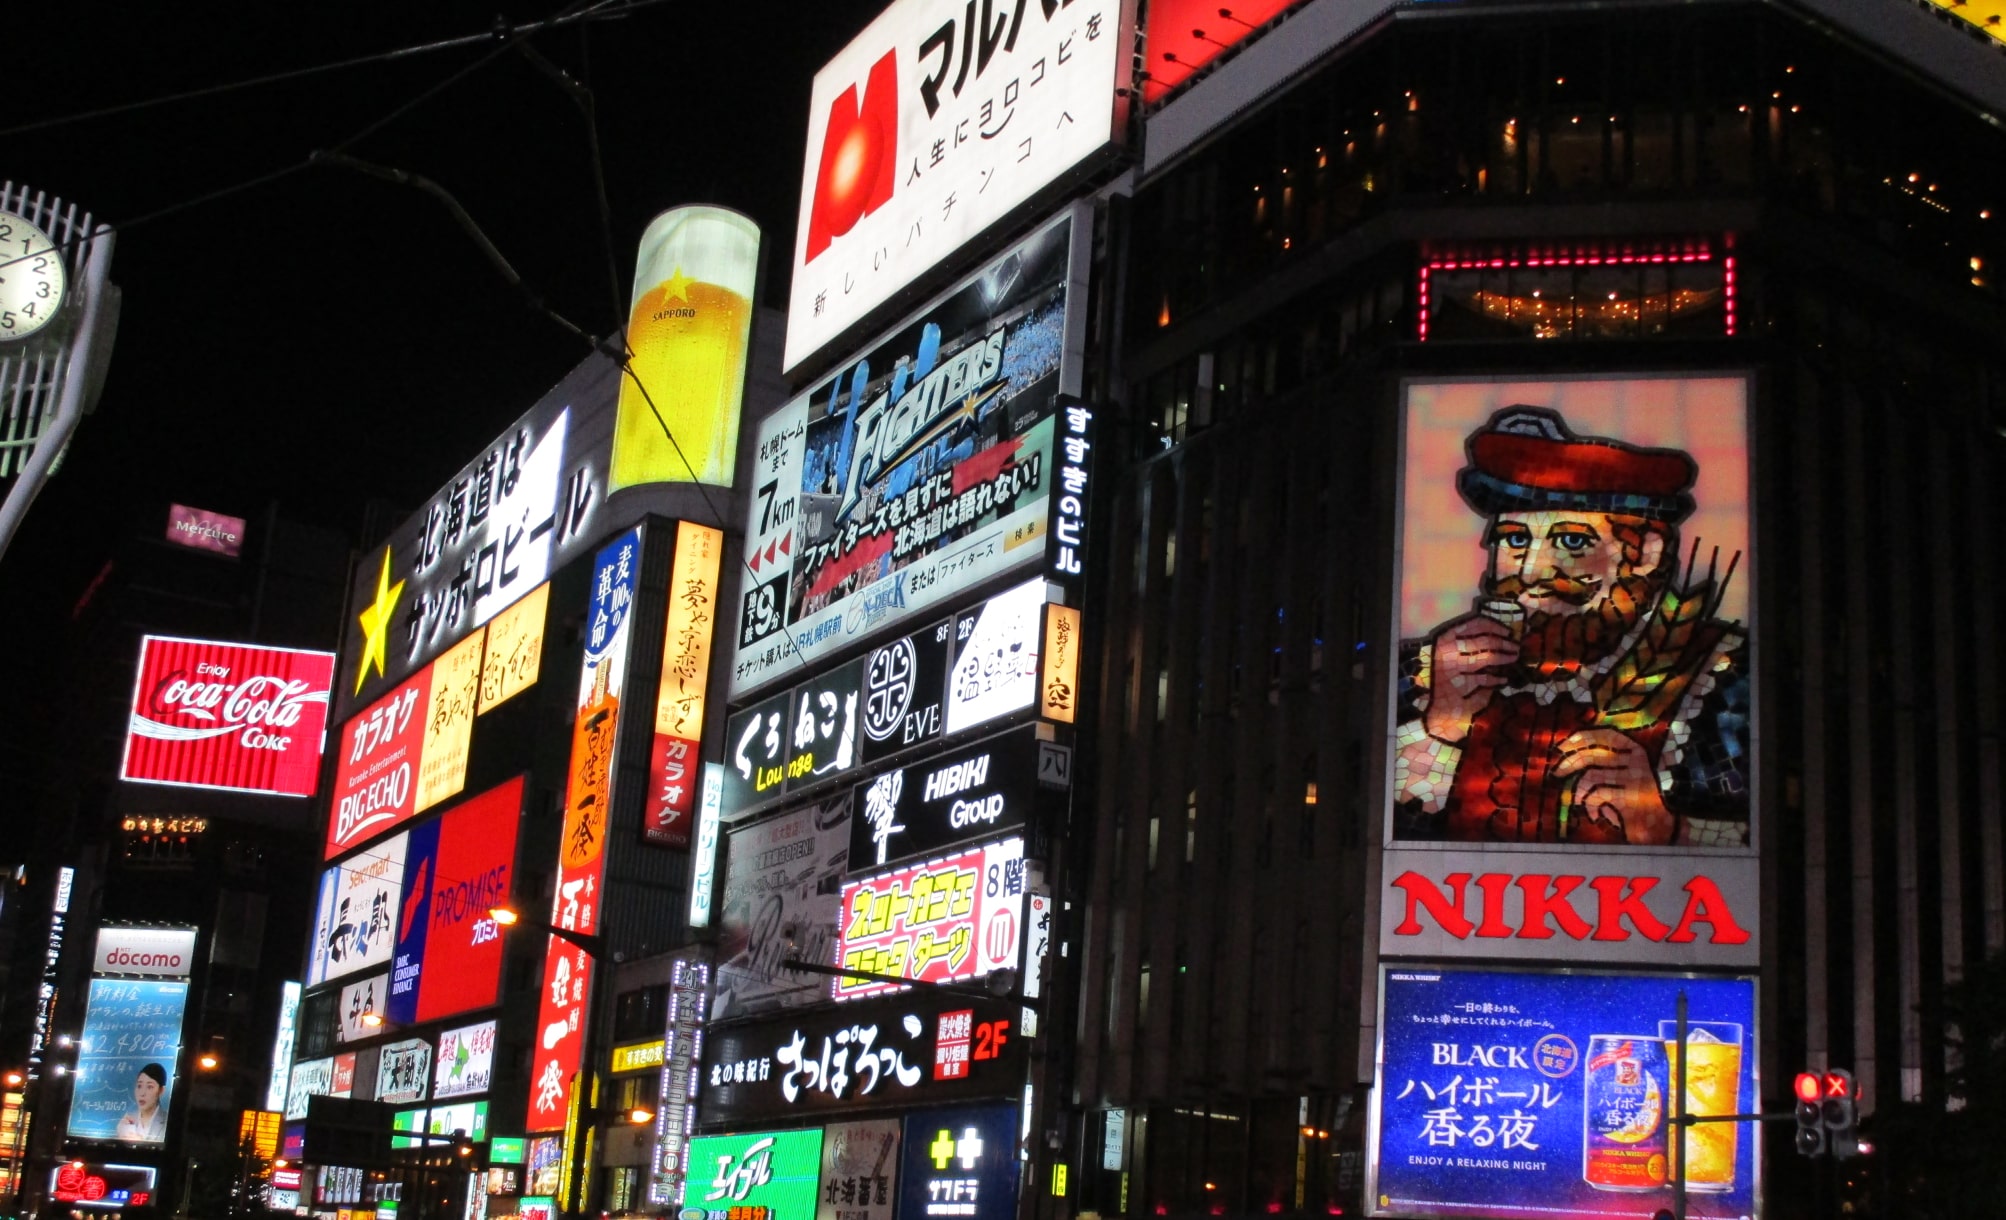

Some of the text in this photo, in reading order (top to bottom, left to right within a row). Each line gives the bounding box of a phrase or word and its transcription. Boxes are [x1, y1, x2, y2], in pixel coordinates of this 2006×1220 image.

[907, 13, 1102, 187] 人生にヨロコビを
[813, 111, 1074, 319] 新しいパチンコへ
[33, 257, 48, 274] 2
[36, 281, 50, 299] 3
[1, 311, 16, 330] 5
[22, 301, 36, 319] 4
[652, 308, 696, 322] SAPPORO
[760, 420, 803, 462] 札幌ドーム
[772, 450, 788, 473] まで
[416, 429, 528, 574] 北海道は
[1056, 407, 1092, 573] すすきのビル
[176, 520, 235, 542] Mercure
[804, 470, 952, 574] ファイターズを見ずに
[1014, 521, 1036, 540] 検索
[407, 467, 595, 663] サッポロビール
[591, 565, 615, 648] 革命
[937, 623, 950, 643] 8F
[958, 617, 975, 640] 2F
[196, 662, 231, 678] Enjoy
[150, 670, 308, 726] Coca-Cola
[240, 727, 292, 752] Coke
[350, 688, 419, 766] カラオケ
[903, 704, 941, 746] EVE
[349, 769, 368, 789] Karaoke
[369, 746, 407, 776] Entertainment
[658, 739, 688, 825] カラオケ
[924, 754, 990, 802] HIBIKI
[951, 792, 1004, 830] Group
[695, 819, 718, 910] グリーンビル
[986, 856, 1024, 899] 8階
[434, 864, 506, 930] PROMISE
[848, 867, 977, 940] ネットカフェ
[1391, 871, 1751, 945] NIKKA
[471, 918, 498, 947] プロミス
[106, 947, 181, 968] docomo
[912, 925, 971, 974] ダーツ
[392, 977, 413, 996] FINANCE
[395, 963, 420, 982] CONSUMER
[1412, 1014, 1554, 1029] ちょっと幸せにしてくれるハイボール。
[1454, 1002, 1520, 1015] 一日の終わりを、
[974, 1021, 1009, 1060] 2F
[1541, 1043, 1573, 1059] 北海道
[1431, 1043, 1530, 1070] BLACK
[1542, 1056, 1567, 1071] 限定
[711, 1057, 770, 1087] 北の味紀行
[1396, 1074, 1563, 1110] ハイボール
[1598, 1096, 1659, 1111] ハイボール
[1418, 1106, 1540, 1151] 香る夜
[1604, 1110, 1650, 1127] 香る夜
[705, 1137, 776, 1201] エイブル
[1409, 1155, 1547, 1171] ENJOY A RELAXING NIGHT
[132, 1193, 149, 1206] 2F
